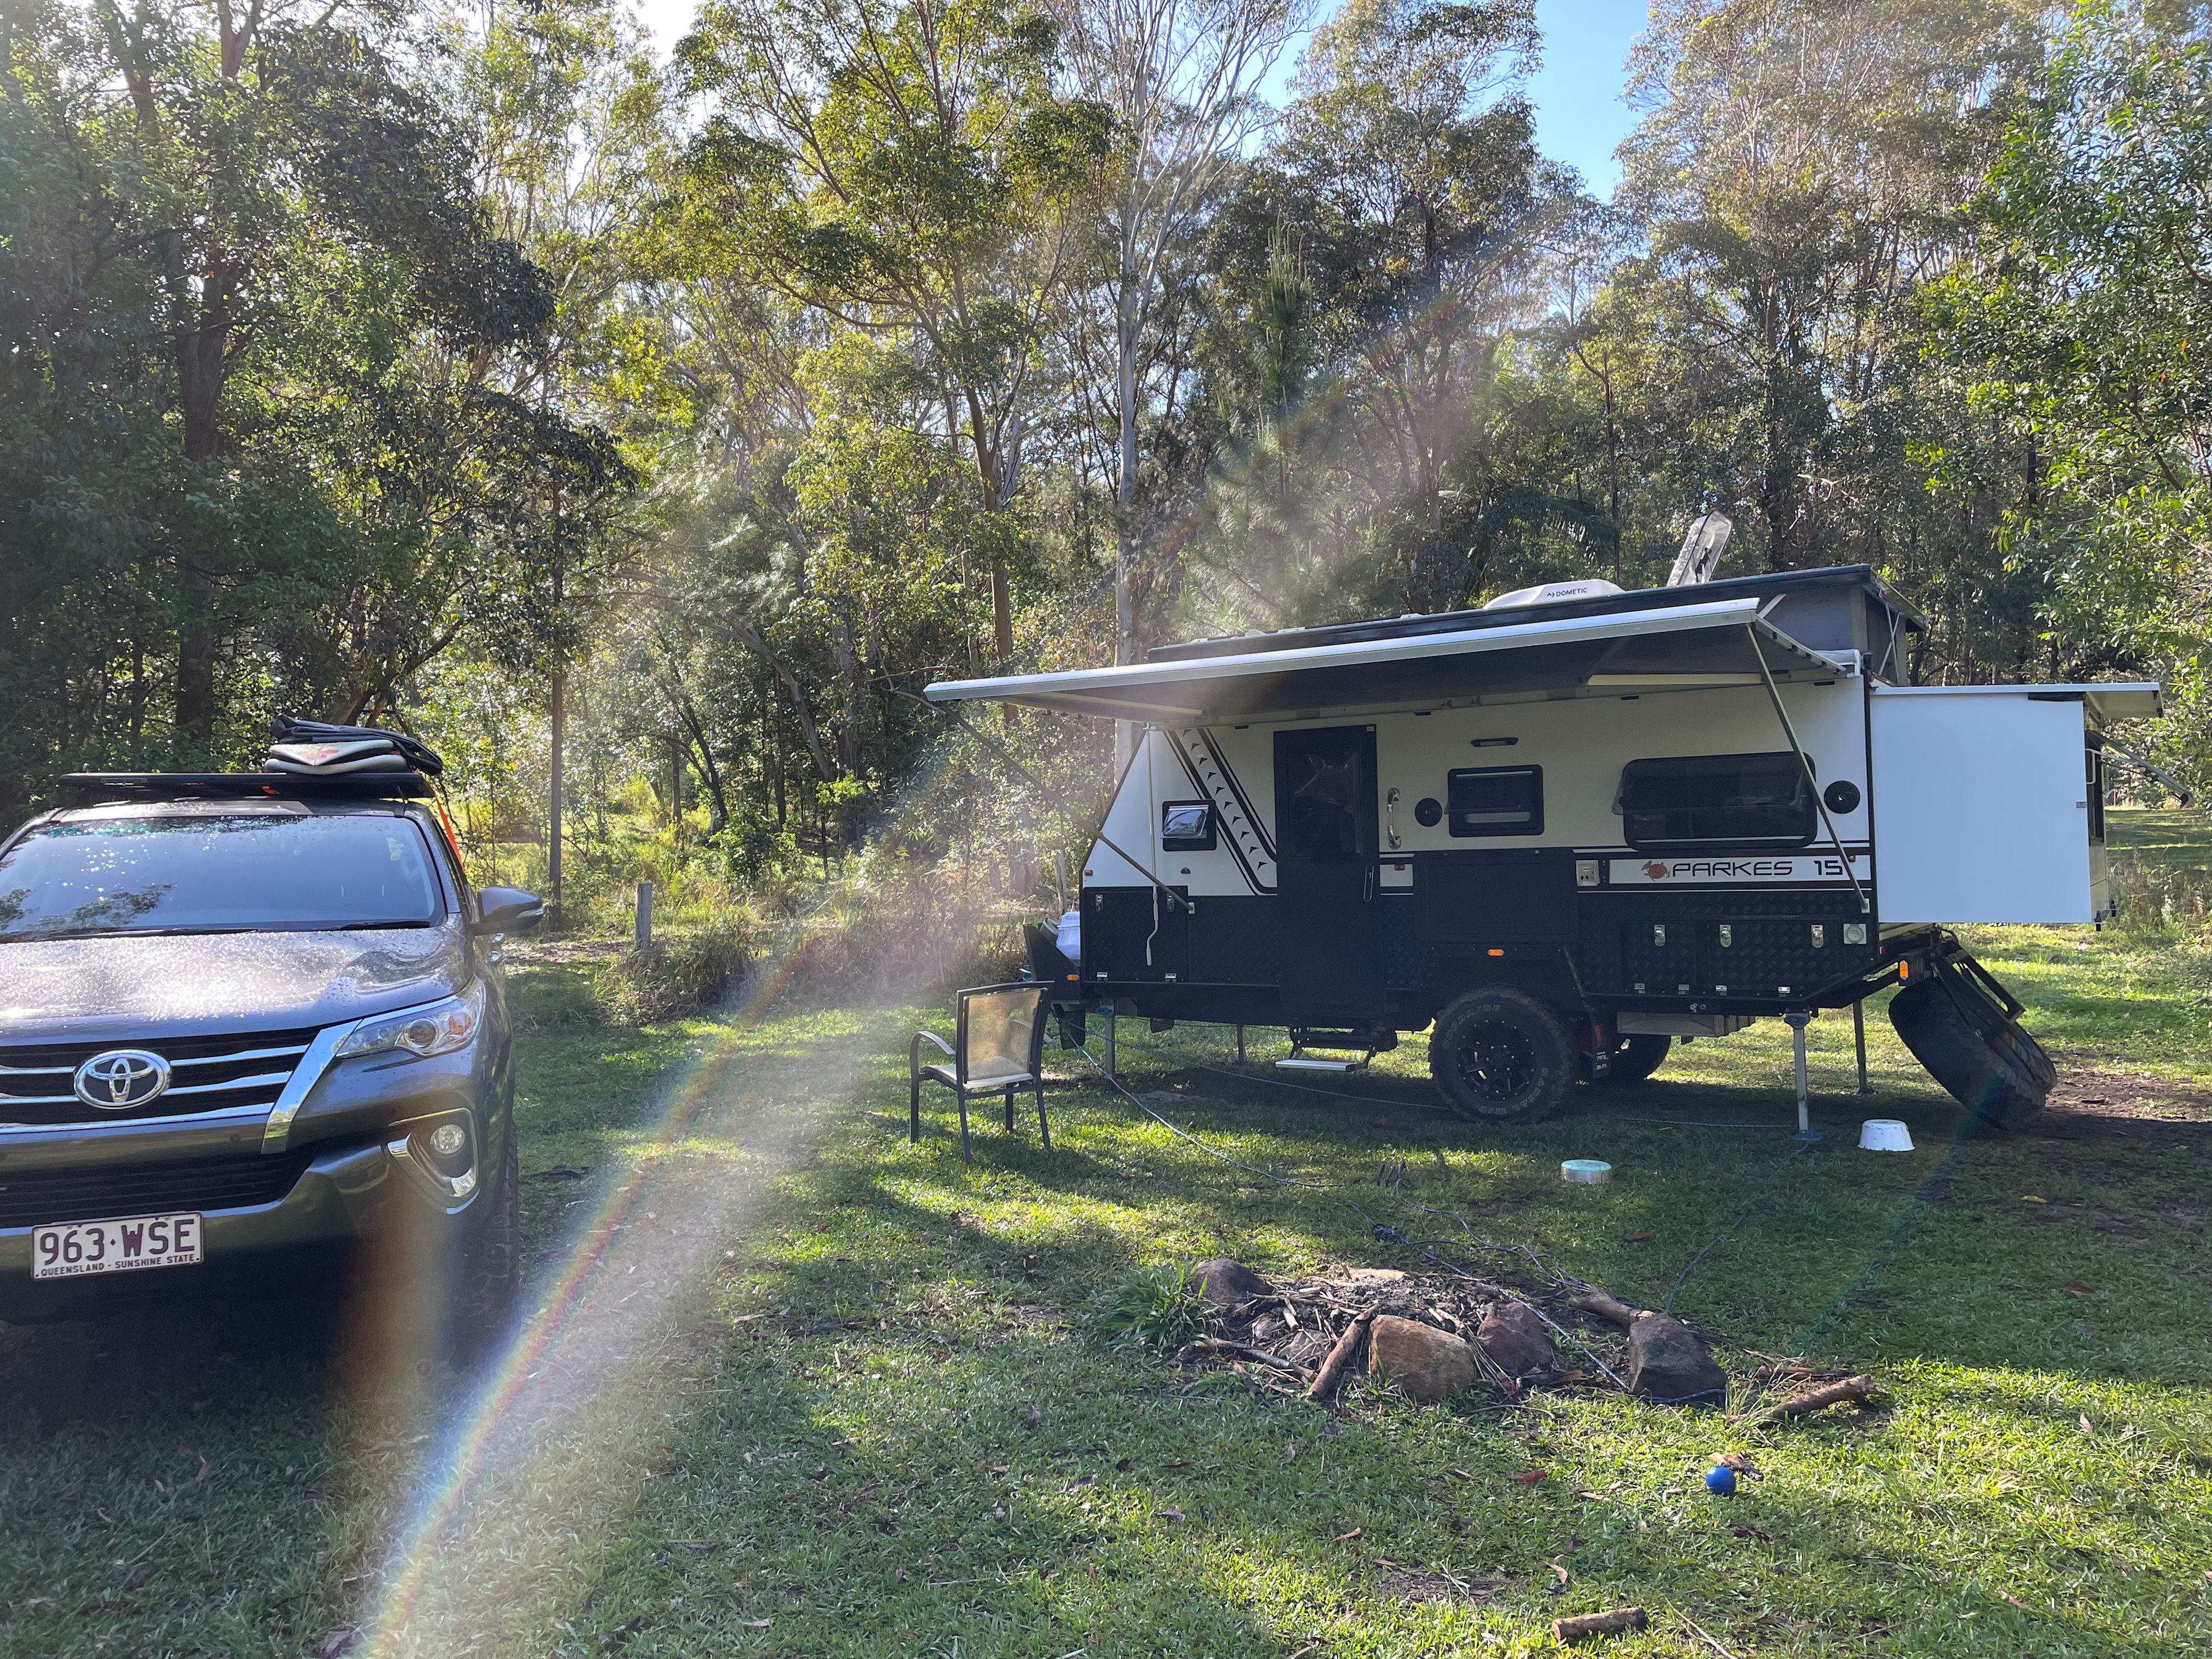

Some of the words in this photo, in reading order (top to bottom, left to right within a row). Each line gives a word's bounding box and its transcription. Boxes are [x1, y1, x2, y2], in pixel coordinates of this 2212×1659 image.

[1556, 588, 1588, 597] DOMETIC
[1672, 861, 1793, 877] PARKES
[1813, 860, 1843, 875] 15
[1442, 1004, 1501, 1049] GOODRIDE
[41, 1264, 104, 1277] QUEENSLAND
[115, 1257, 162, 1269] SUNSHINE
[166, 1254, 194, 1264] STATE
